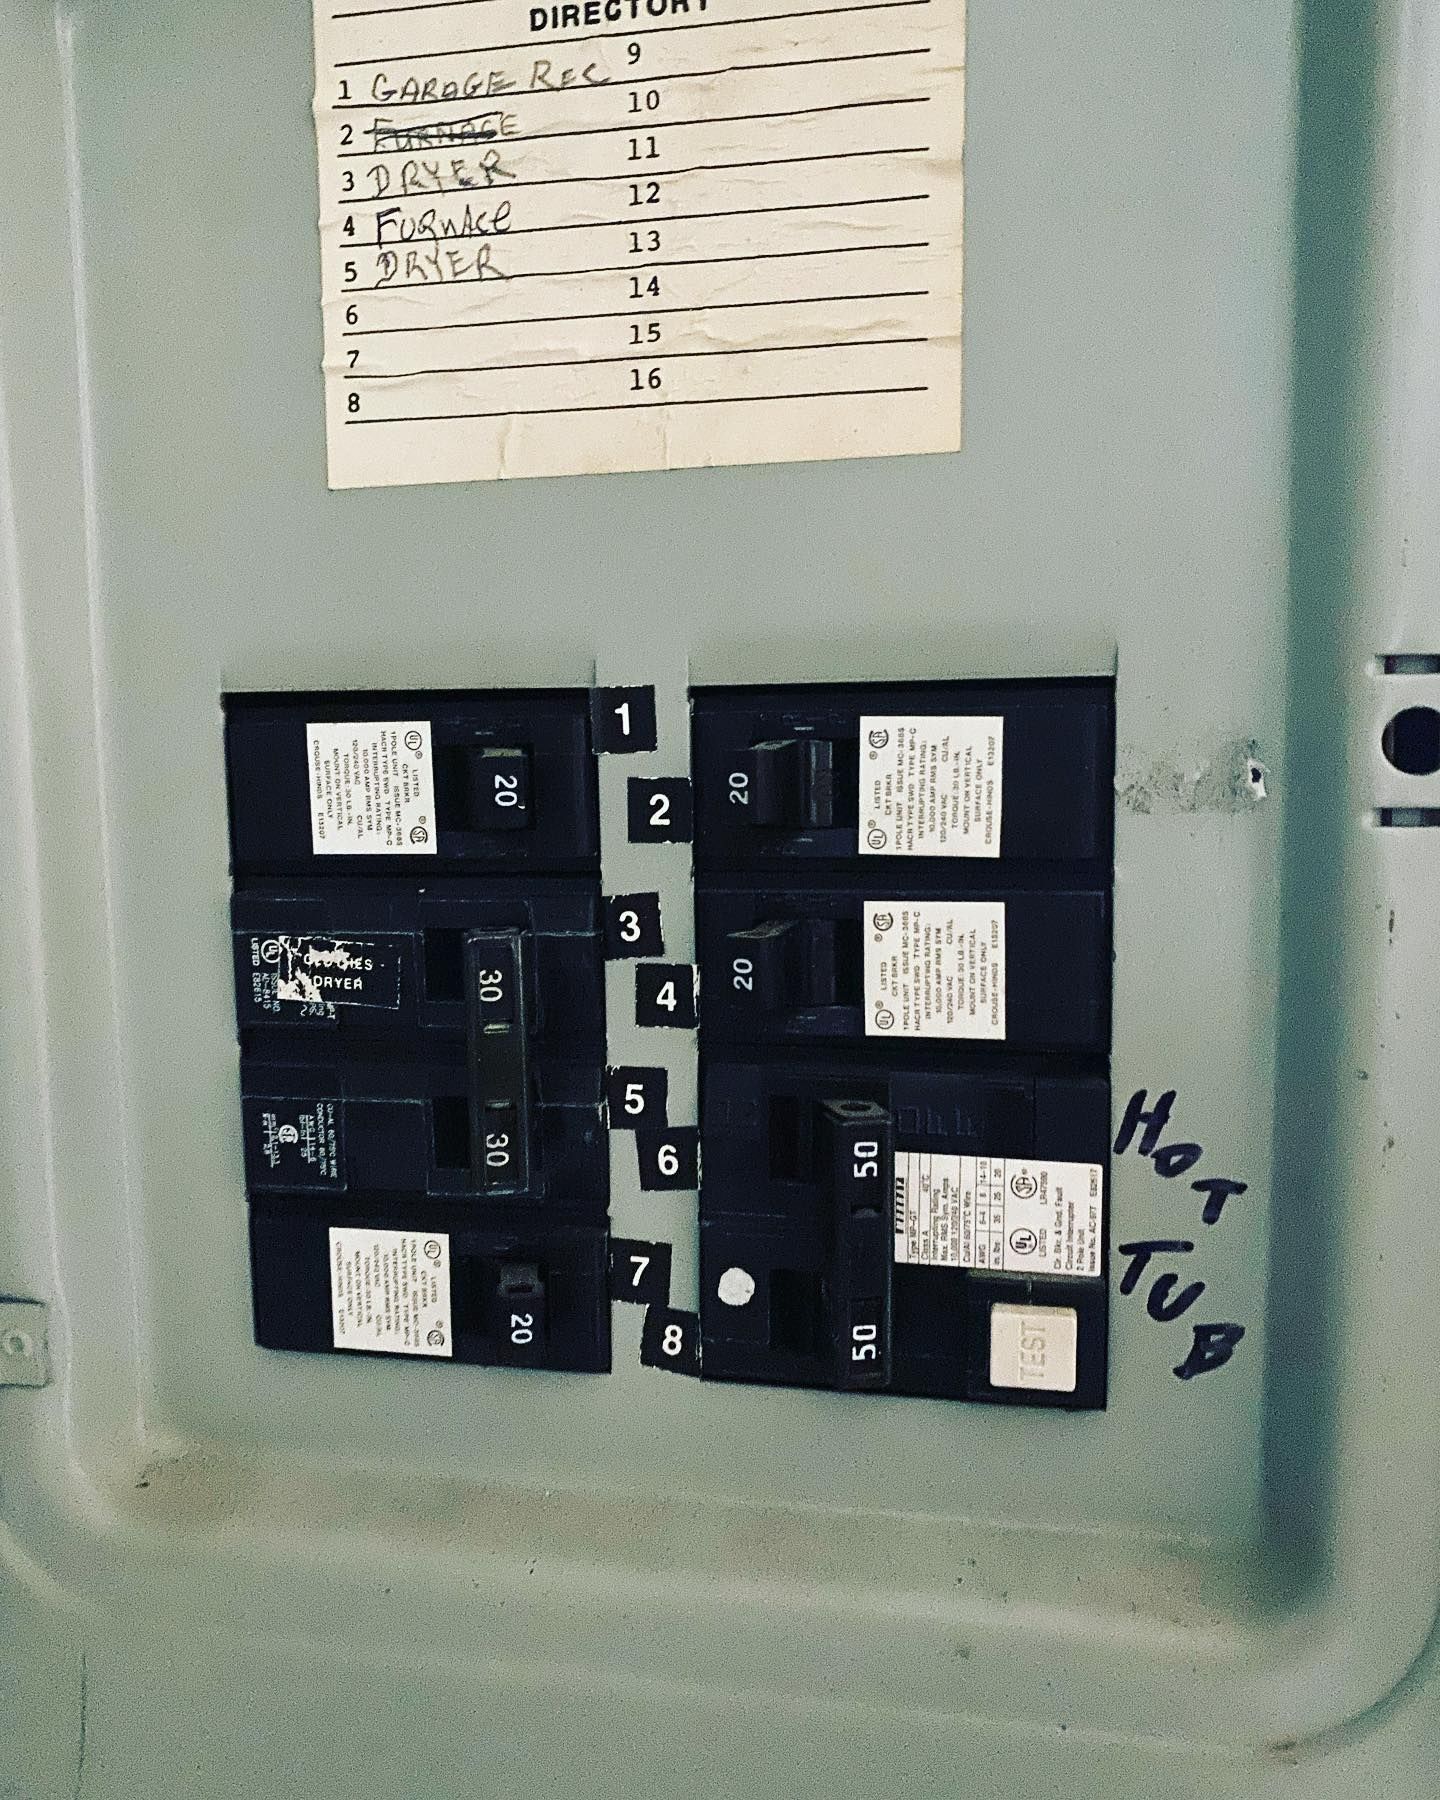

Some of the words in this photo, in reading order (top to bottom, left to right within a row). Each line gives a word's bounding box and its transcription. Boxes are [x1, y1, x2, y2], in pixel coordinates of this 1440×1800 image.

[628, 43, 640, 65] 9
[338, 80, 351, 100] 1
[371, 72, 516, 101] GARAGE
[628, 90, 659, 113] 10
[340, 124, 353, 145] 2
[628, 137, 660, 160] 11
[342, 171, 354, 191] 3
[367, 150, 516, 198] DRYER
[629, 182, 660, 206] 12
[343, 216, 355, 236] 4
[629, 231, 660, 253] 13
[345, 261, 357, 282] 5
[376, 243, 509, 288] DRYER
[630, 276, 659, 298] 14
[346, 305, 358, 325] 6
[629, 323, 660, 344] 15
[347, 350, 359, 368] 7
[630, 368, 661, 390] 16
[348, 393, 360, 412] 8
[619, 703, 629, 734] 1
[314, 740, 322, 799] CROUSE-HINDS
[372, 743, 380, 800] INTERRUPTING
[964, 746, 972, 788] VERTICAL
[335, 779, 341, 789] ON
[495, 775, 517, 806] 20
[729, 773, 748, 804] 20
[953, 781, 958, 790] 30
[964, 791, 970, 801] ON
[650, 794, 670, 825] 2
[918, 779, 926, 838] INTERRUPTING
[985, 780, 993, 844] CROUSE-HINDS
[619, 911, 640, 941] 3
[251, 937, 260, 966] LISTED
[733, 959, 752, 990] 20
[958, 963, 964, 972] 30
[969, 973, 976, 984] ON
[314, 976, 363, 990] DRYER
[480, 970, 502, 1001] 30
[657, 982, 676, 1011] 4
[625, 1084, 644, 1114] 5
[316, 1103, 325, 1144] CONDUCTOR
[486, 1134, 509, 1166] 30
[658, 1145, 678, 1175] 6
[854, 1142, 878, 1177] 50
[1113, 1089, 1248, 1225] HOT
[931, 1189, 940, 1213] Rating
[910, 1241, 919, 1259] Type
[932, 1216, 940, 1260] Interrupting
[630, 1256, 649, 1286] 7
[1118, 1240, 1246, 1380] TUB
[511, 1314, 533, 1344] 20
[662, 1325, 682, 1355] 8
[852, 1325, 876, 1360] 50
[1020, 1321, 1045, 1381] TEST
